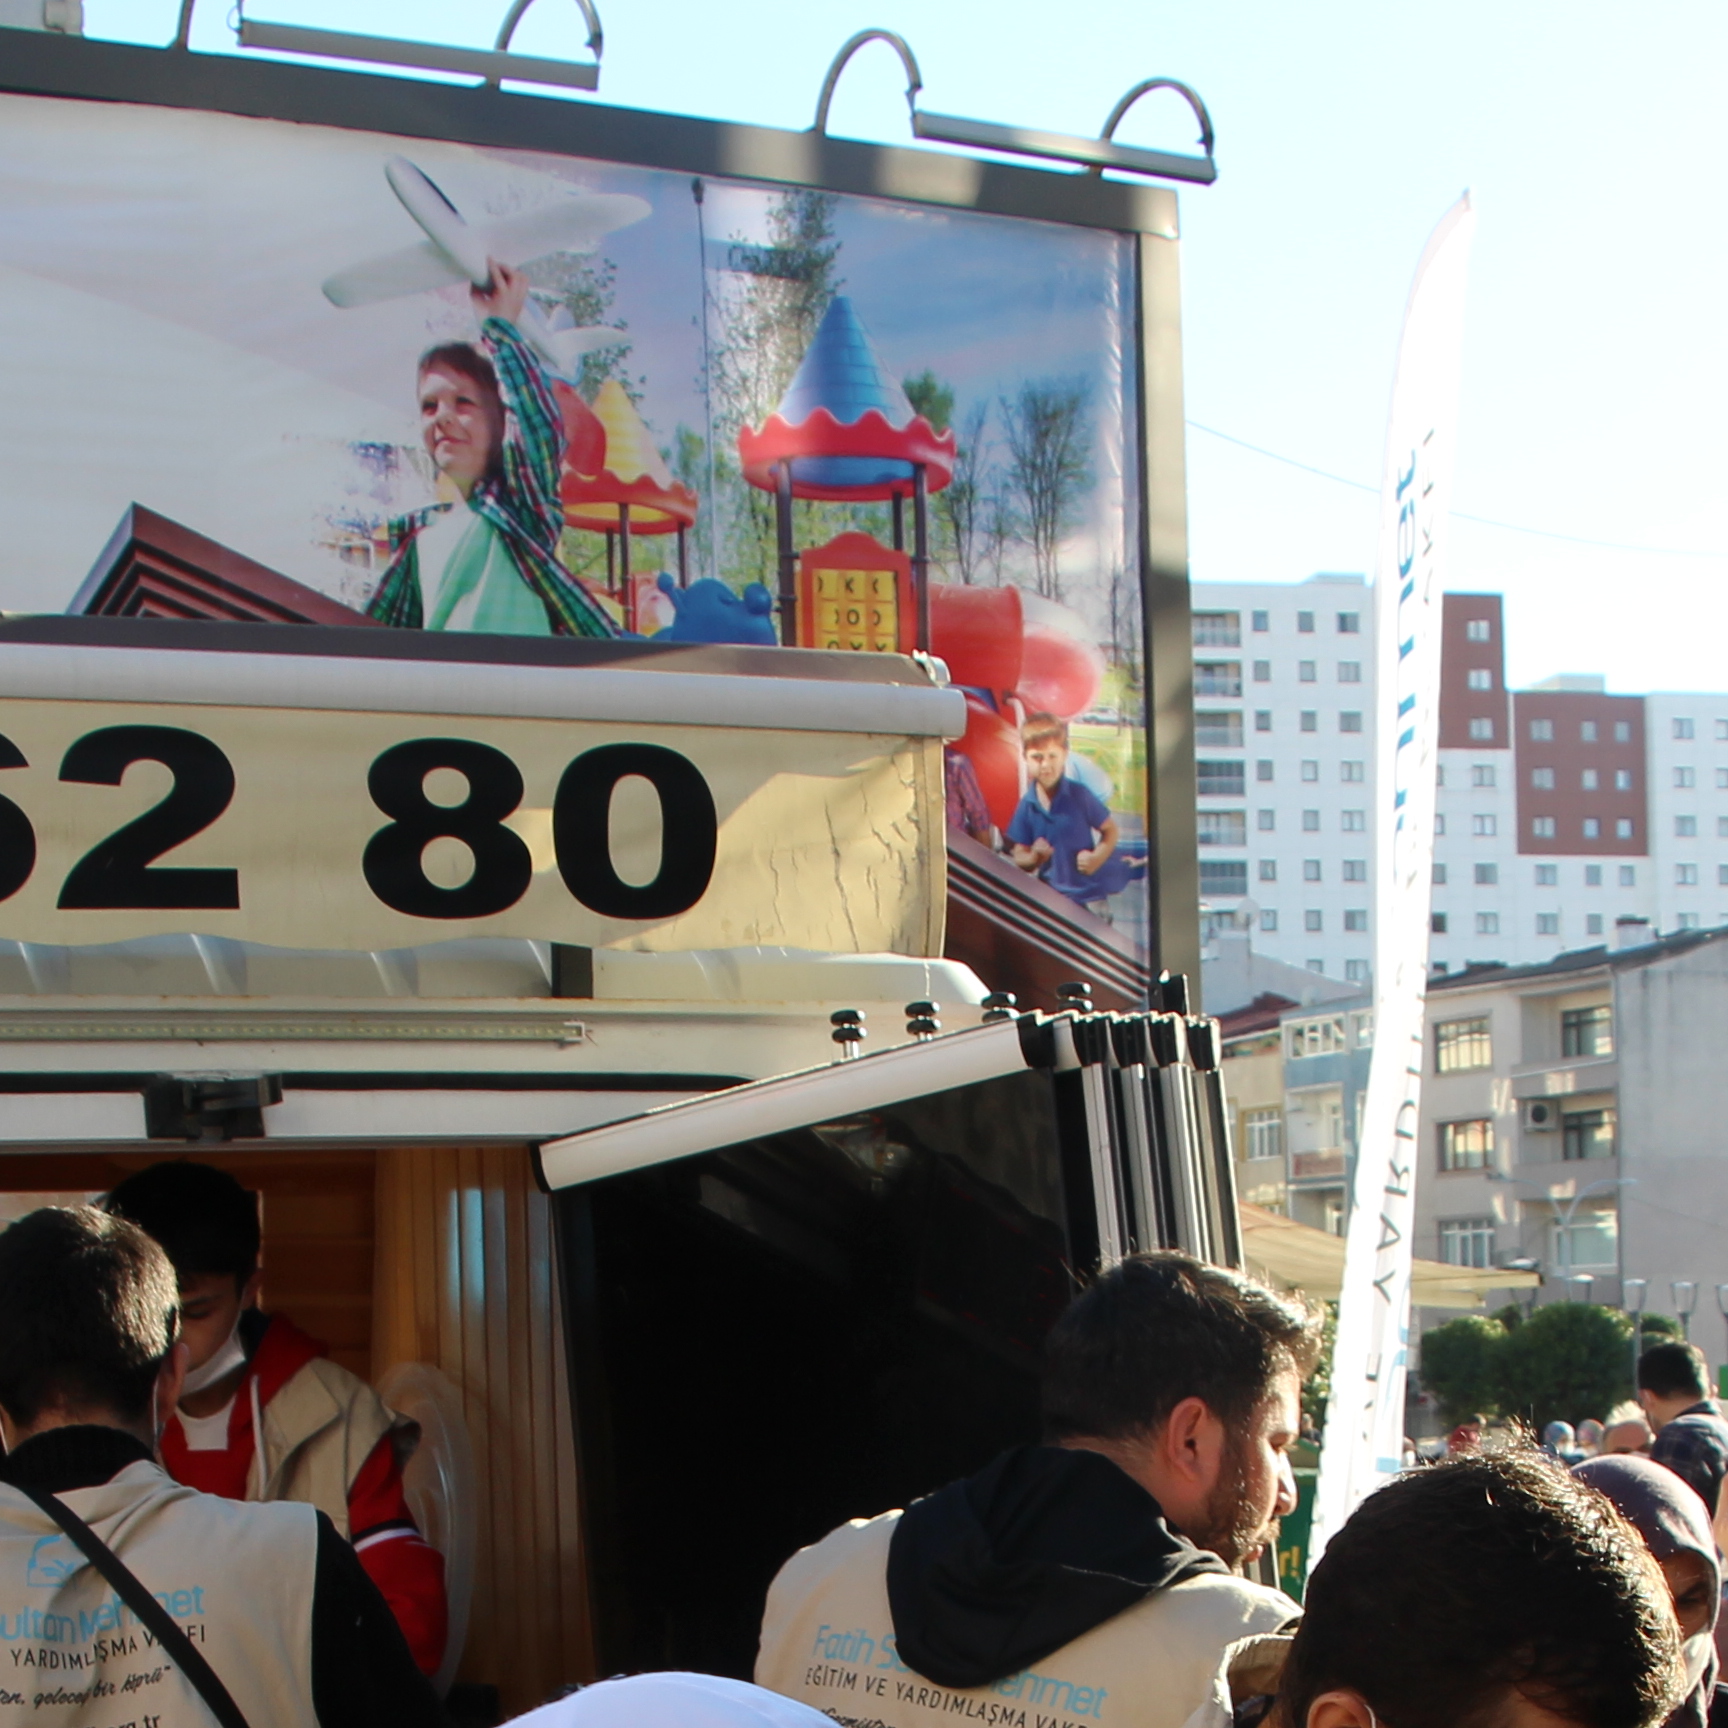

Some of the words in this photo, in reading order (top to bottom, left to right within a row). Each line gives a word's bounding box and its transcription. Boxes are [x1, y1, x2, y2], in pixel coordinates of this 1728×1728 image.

[362, 737, 718, 920] 80
[144, 1624, 206, 1648] VFI
[804, 1664, 858, 1691] EĞİTİM
[864, 1676, 889, 1697] VE
[813, 1624, 876, 1665] Fatih
[990, 1667, 1110, 1720] ehmet
